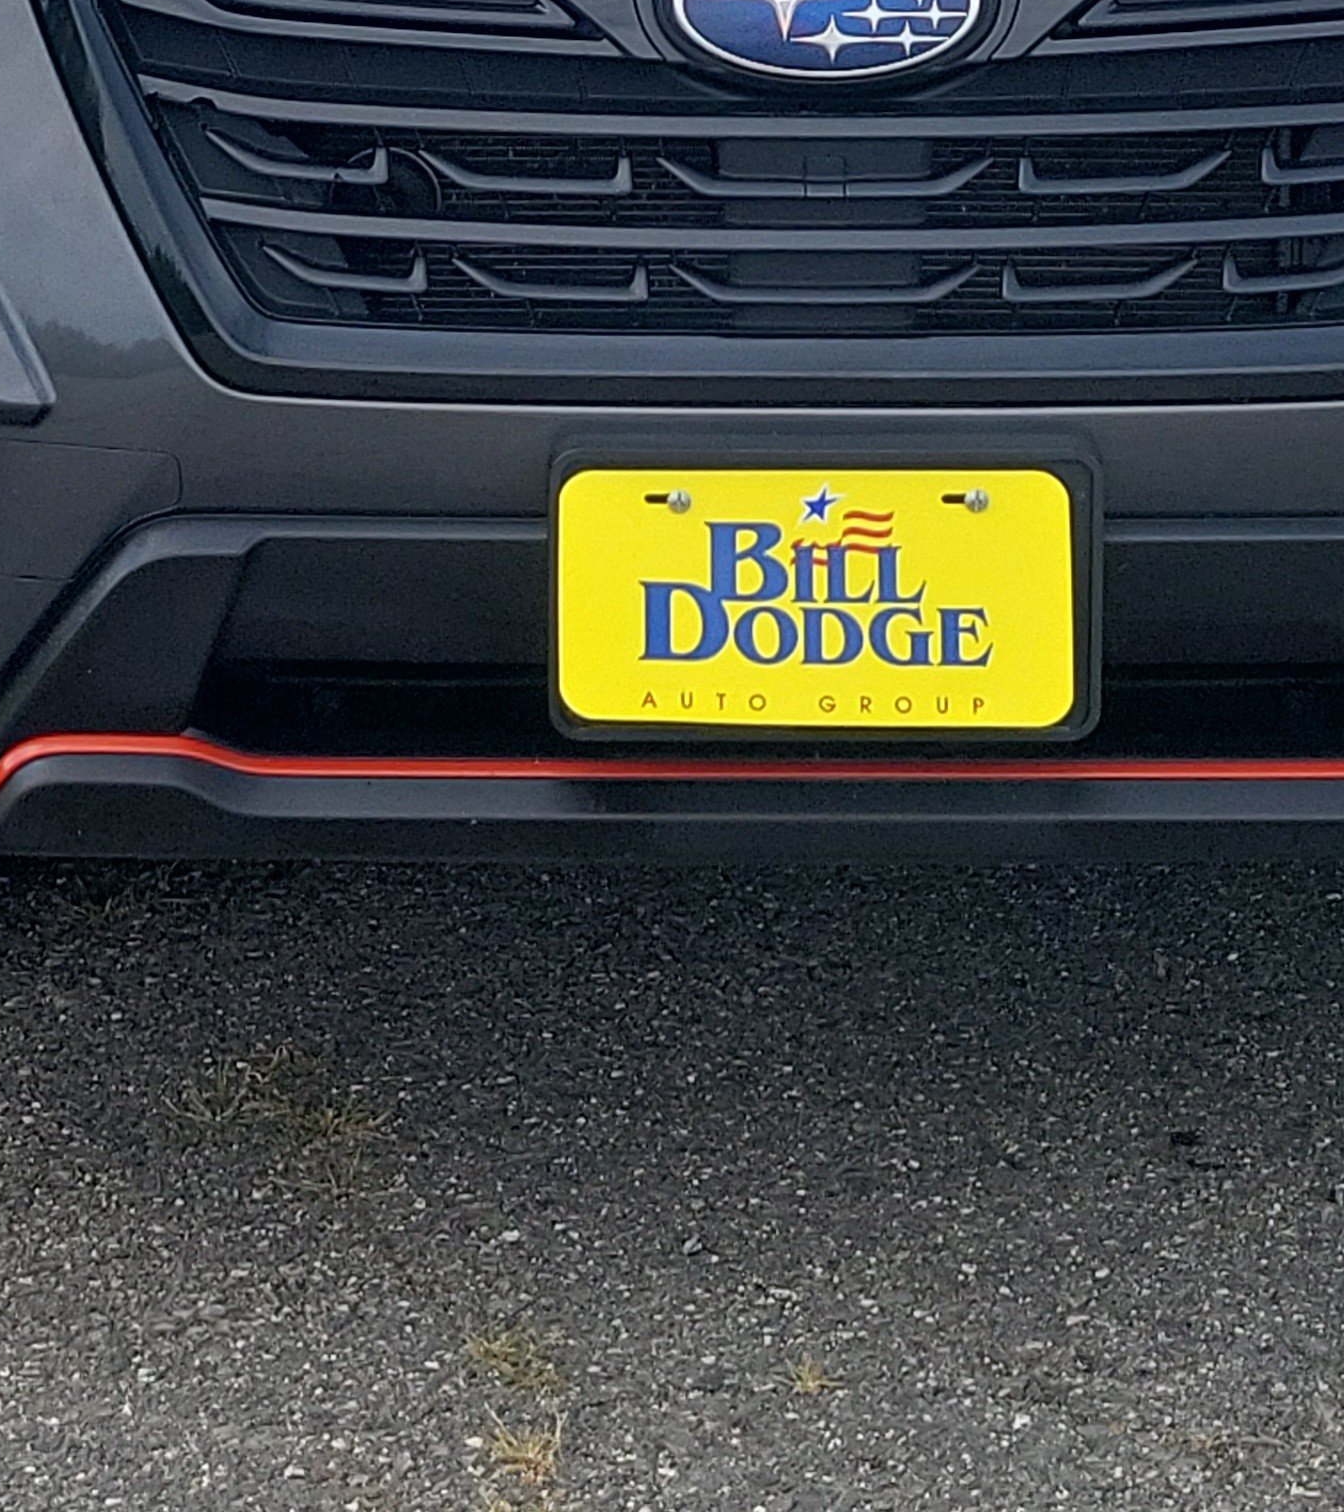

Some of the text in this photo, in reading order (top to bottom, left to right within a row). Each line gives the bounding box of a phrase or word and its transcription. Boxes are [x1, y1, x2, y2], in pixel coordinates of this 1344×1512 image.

[705, 521, 926, 603] BILL
[638, 580, 994, 667] DODGE
[641, 691, 986, 715] AUTO GROUP
